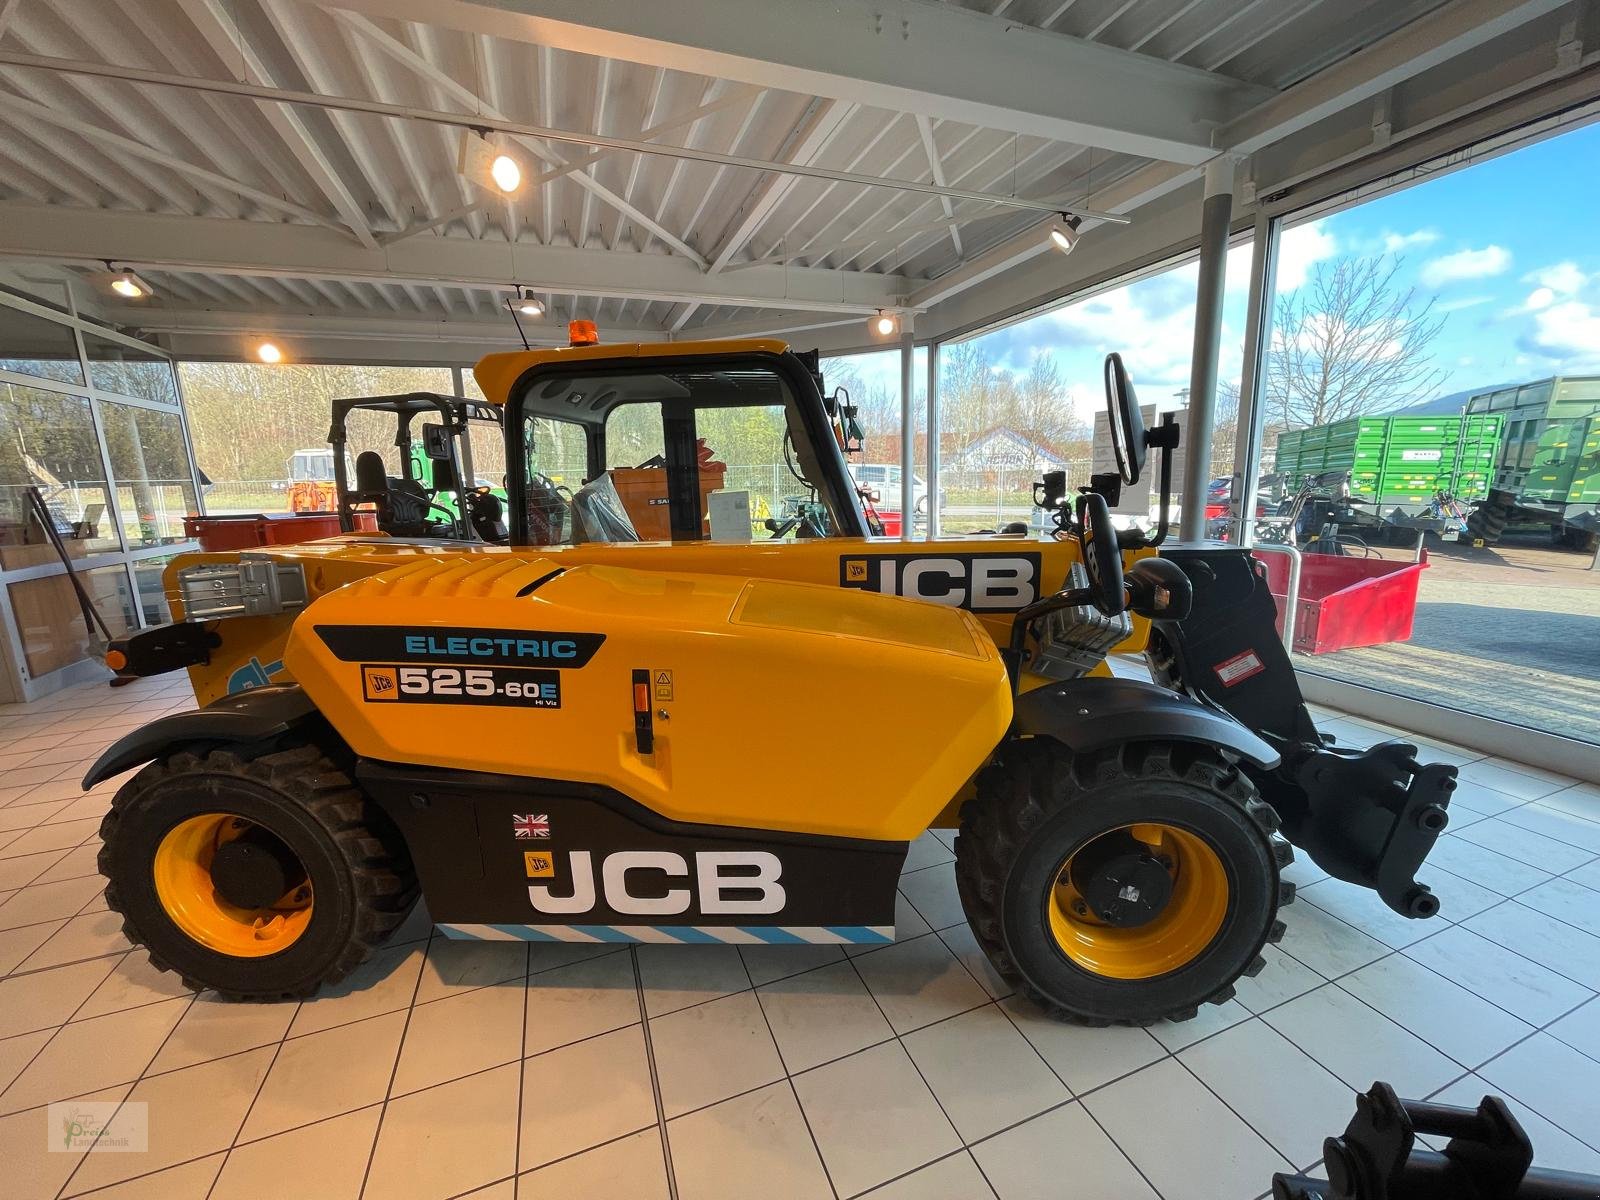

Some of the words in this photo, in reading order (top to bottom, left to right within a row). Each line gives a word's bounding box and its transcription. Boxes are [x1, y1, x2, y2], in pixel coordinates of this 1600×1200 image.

[840, 558, 1034, 608] JCB
[405, 636, 577, 658] ELECTRIC
[371, 674, 394, 692] JCB
[531, 858, 550, 871] JCB
[528, 851, 786, 914] JCB
